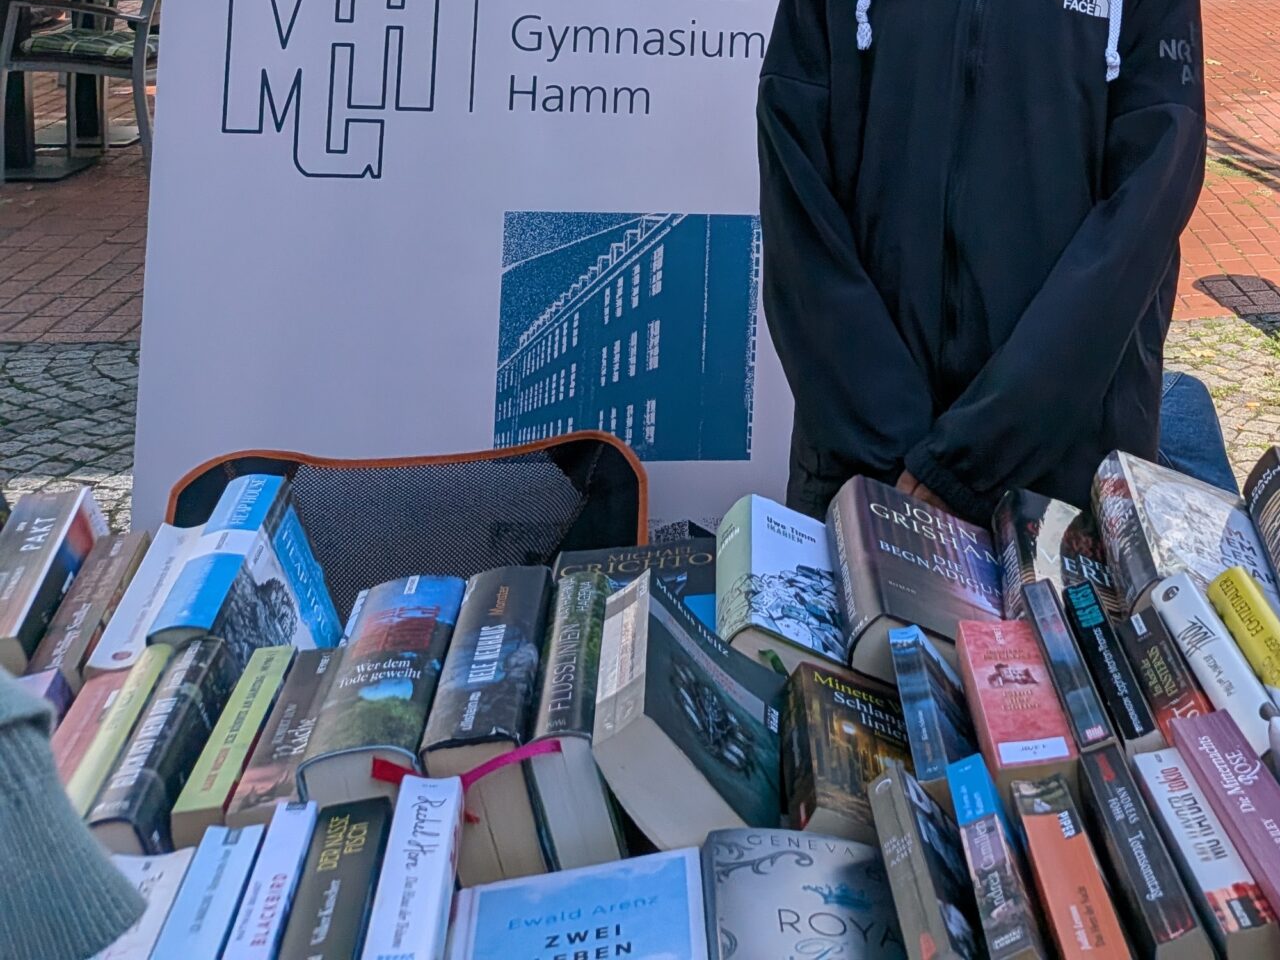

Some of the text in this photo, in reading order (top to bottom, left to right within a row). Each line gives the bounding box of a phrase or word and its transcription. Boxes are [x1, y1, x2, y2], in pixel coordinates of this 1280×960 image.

[511, 14, 766, 62] Gymnasium
[508, 74, 651, 115] Hamm
[246, 478, 267, 508] HOUSE
[20, 517, 56, 552] PAKT
[766, 515, 816, 544] Uwe Timm
[766, 523, 803, 545] IKARIEN
[903, 502, 977, 545] JOHN
[608, 546, 694, 563] MICHAEL
[933, 554, 963, 573] DIE
[489, 586, 509, 617] Monster
[577, 581, 592, 611] HAGENA
[1219, 577, 1264, 638] ECHTZEITALTER
[656, 577, 729, 658] Markus Heitz
[355, 658, 411, 674] Wer dem
[468, 624, 507, 685] NELE NEUHAUS
[549, 624, 580, 712] FLUSSLINIEN
[370, 668, 423, 683] geweiht
[814, 672, 884, 707] Minette
[1085, 726, 1105, 740] Bild
[1160, 767, 1189, 793] tokio
[1198, 736, 1256, 813] Die Mitternachts
[1225, 749, 1260, 786] ROSE
[410, 795, 447, 846] Rachel
[1107, 798, 1125, 821] FÖHR
[1116, 786, 1139, 825] ANDREAS
[1169, 792, 1210, 838] HAYDER
[326, 814, 351, 846] NASSE
[345, 822, 370, 856] FISCH
[1058, 810, 1076, 839] PIPER
[747, 834, 853, 857] GENEVA
[1128, 831, 1163, 901] Totensonntag
[250, 872, 288, 947] BLACKBIRD
[507, 895, 660, 931] Ewald Arenz
[545, 924, 622, 949] ZWEI
[778, 908, 899, 947] ROYA
[533, 942, 633, 960] EBEN
